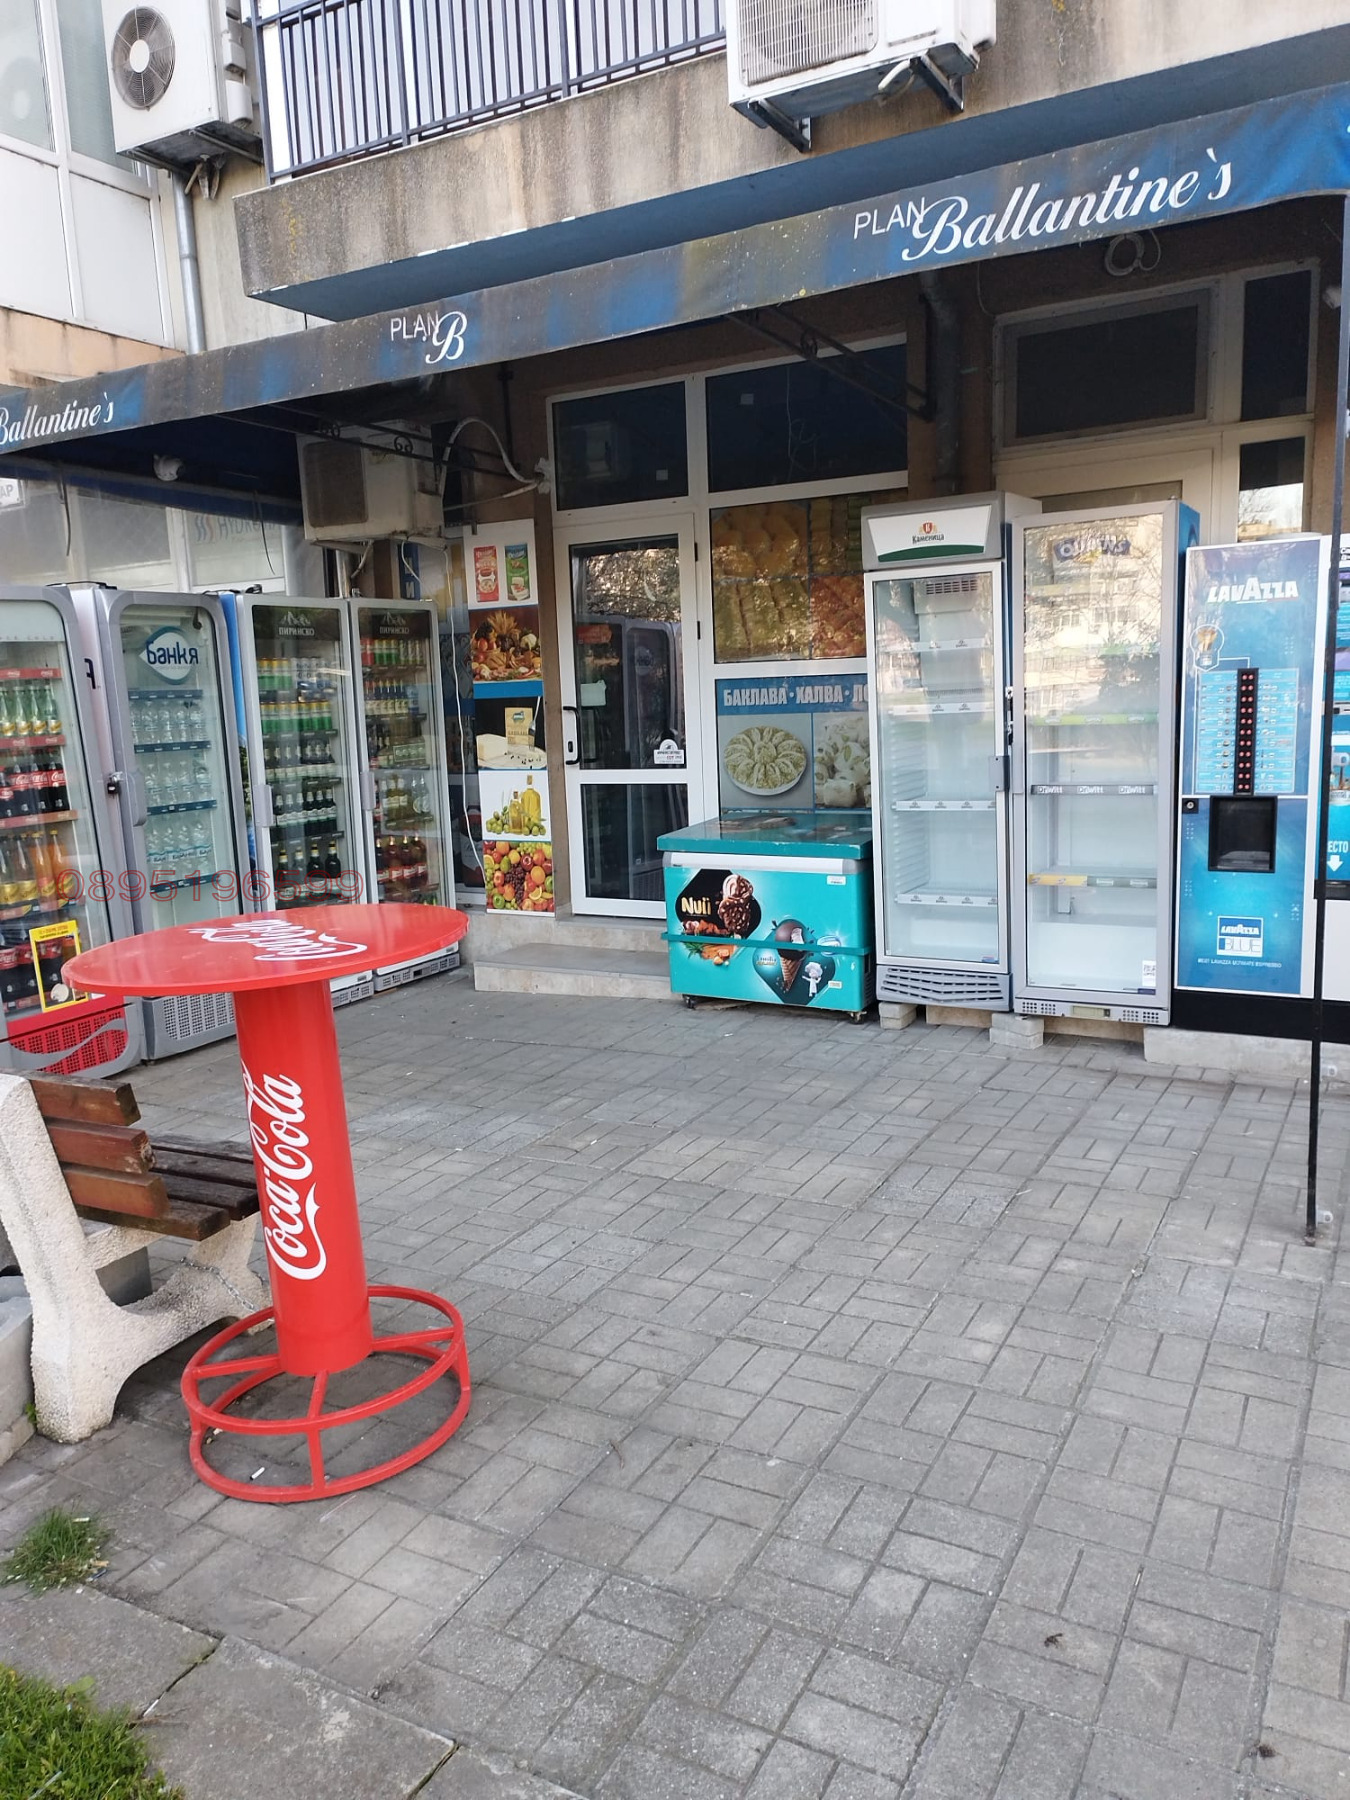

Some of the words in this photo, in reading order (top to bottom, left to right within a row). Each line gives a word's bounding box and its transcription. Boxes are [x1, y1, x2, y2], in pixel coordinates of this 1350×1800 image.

[853, 196, 925, 240] PLAN
[901, 147, 1232, 261] Ballantine's
[390, 310, 439, 341] PLAN
[425, 311, 468, 364] B
[1206, 576, 1299, 603] LAVAZZA
[278, 626, 315, 637] ПИРИНСКО
[723, 687, 788, 707] БАКЛАВА
[795, 685, 844, 704] ХАЛВА
[1327, 840, 1349, 853] ЕСТО
[681, 897, 712, 915] Nuii
[184, 919, 368, 960] Coca-Cola
[1221, 924, 1260, 935] LAVAZZA
[1224, 938, 1261, 953] BLUE
[240, 1058, 327, 1281] Coca-Cola
